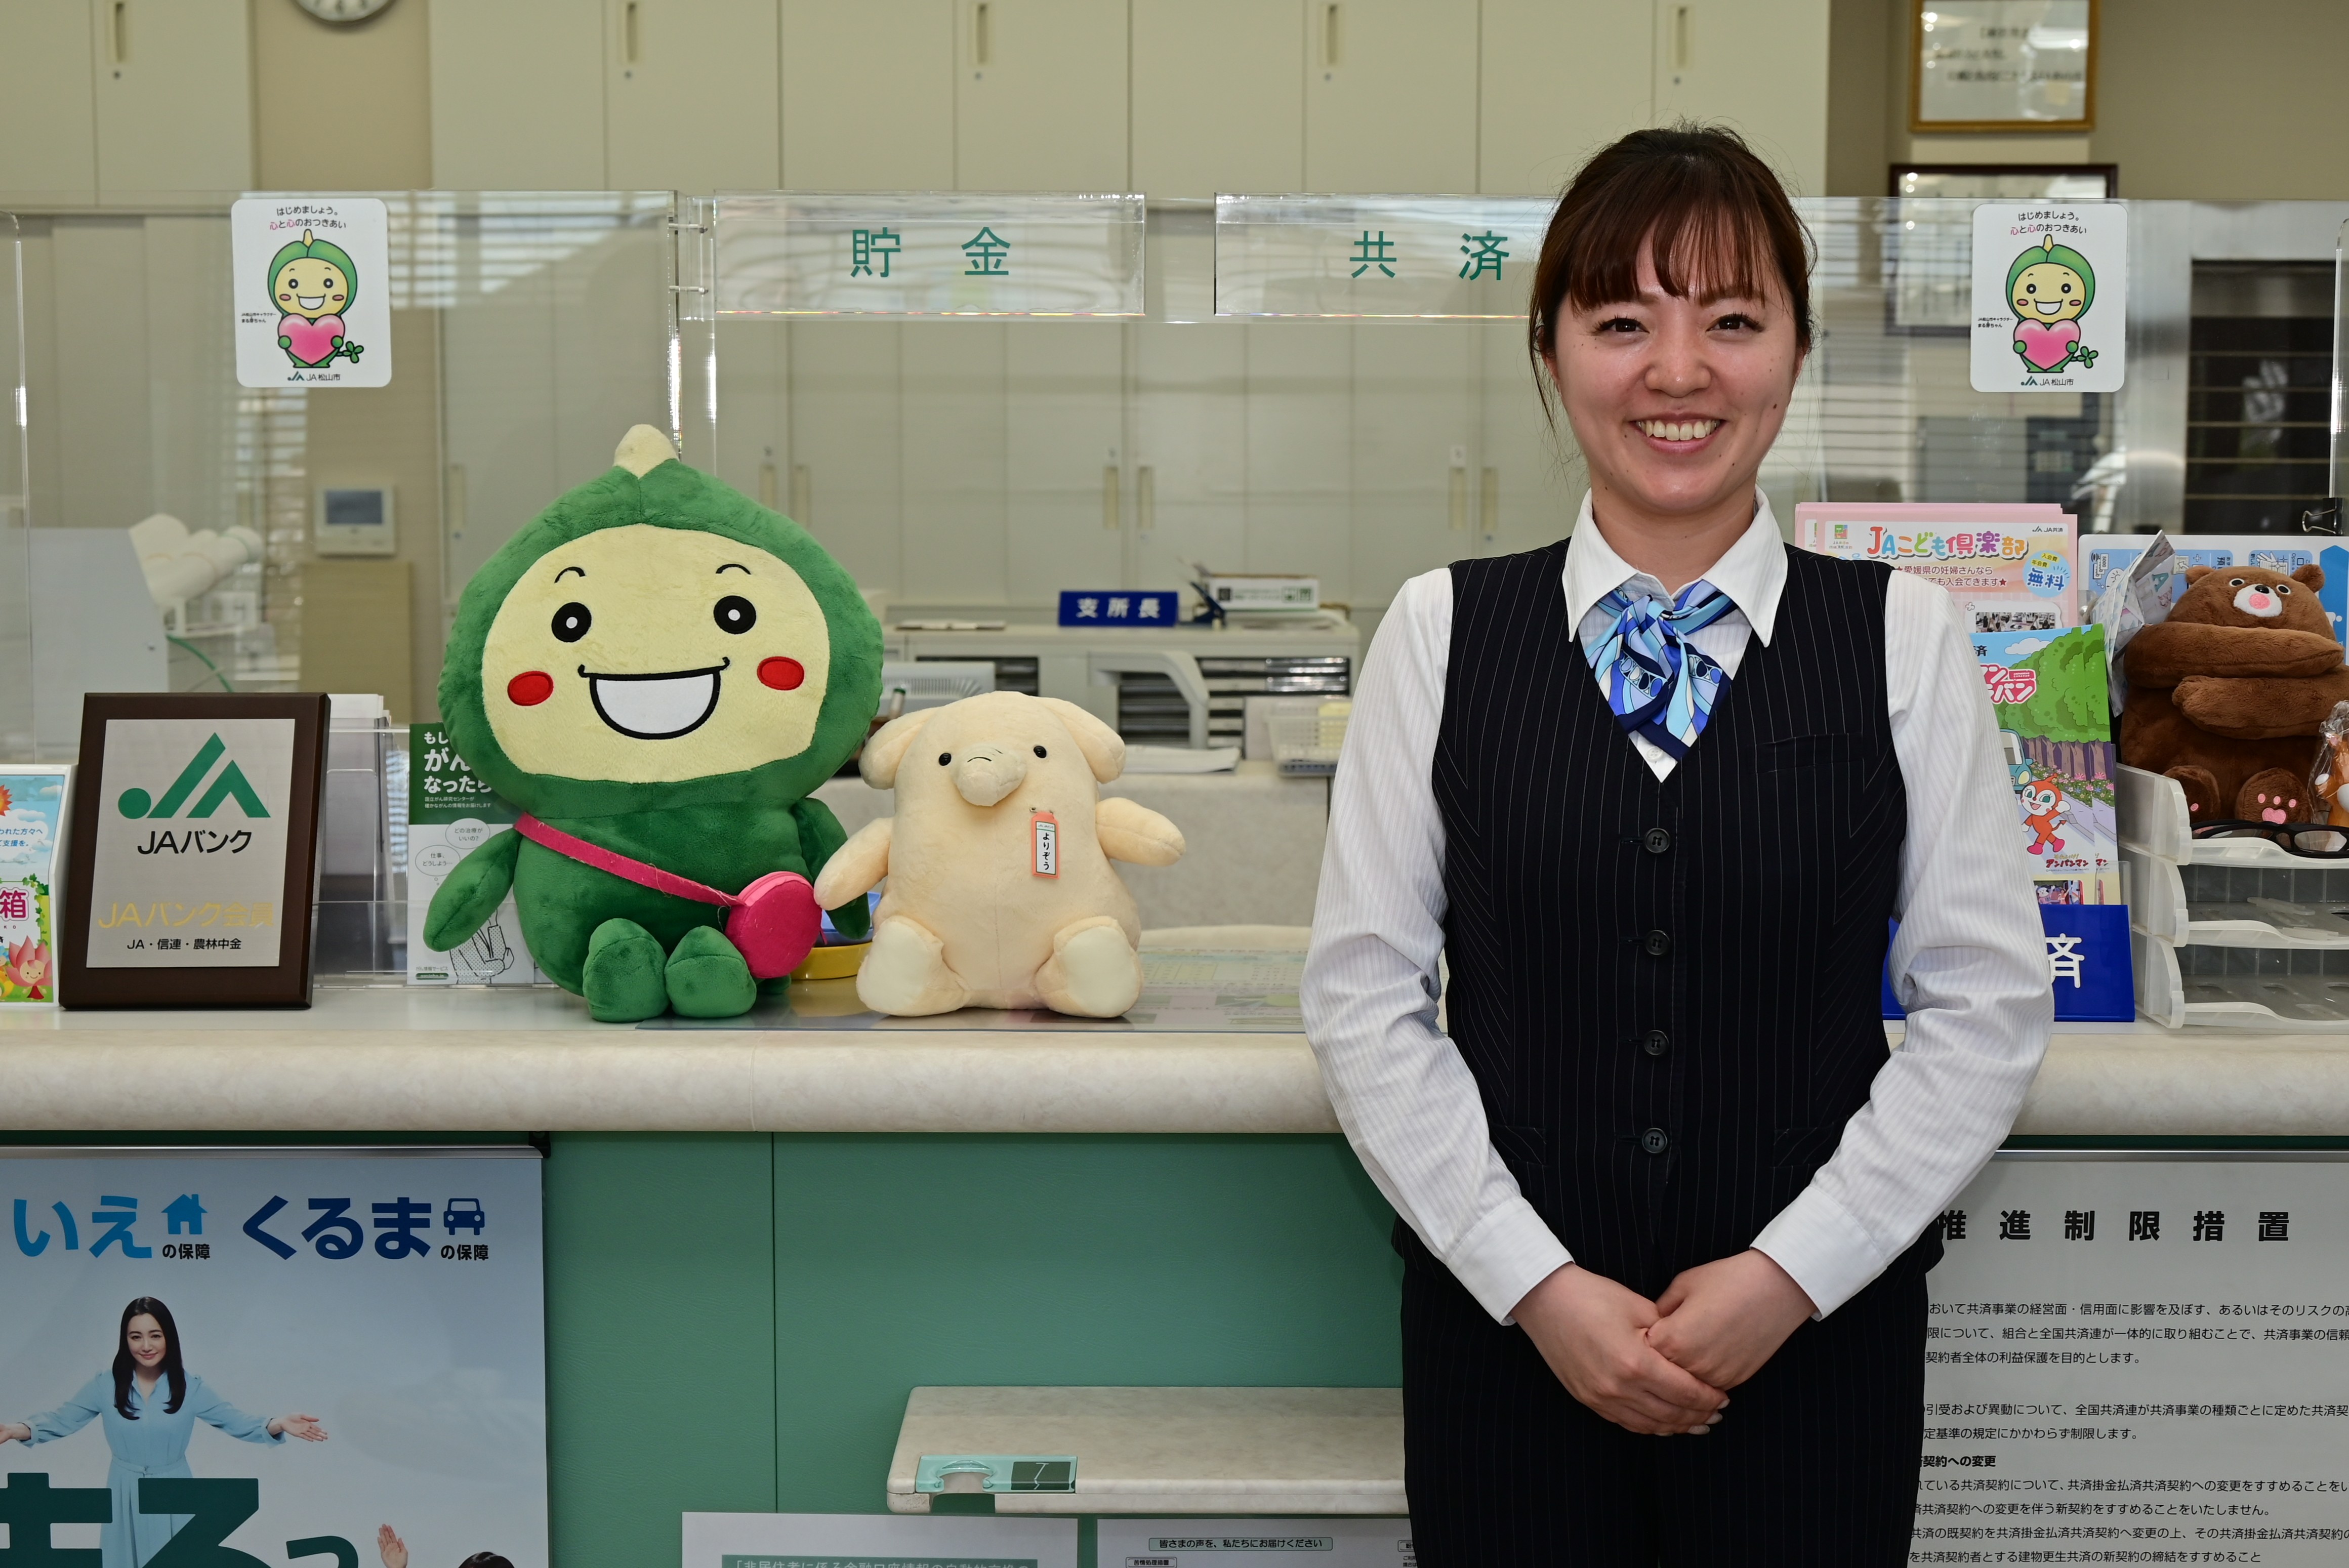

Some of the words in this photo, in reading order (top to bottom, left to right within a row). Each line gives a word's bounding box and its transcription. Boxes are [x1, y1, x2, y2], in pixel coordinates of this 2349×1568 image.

[276, 205, 339, 216] はじめましょう。
[2018, 211, 2079, 221] はじめましょう。
[269, 218, 346, 231] 心と心のおつきあい
[2010, 224, 2087, 235] 心と心のおつきあい
[1867, 526, 2026, 557] JAこども倶楽部
[2027, 567, 2065, 591] 無料
[1076, 597, 1161, 619] 支所長
[137, 830, 253, 854] JAバンク
[1042, 832, 1050, 870] よりぞう
[2045, 859, 2089, 868] アンパンマン
[97, 902, 273, 928] JAバンク会員
[13, 1195, 152, 1259] いえ
[162, 1243, 211, 1260] の保障
[242, 1194, 432, 1260] くるま
[440, 1244, 489, 1261] の保障
[1923, 1404, 2348, 1417] 引受および異動について、全国共済連が共済事業の種類ごとに定めた共済契
[1159, 1539, 1323, 1549] 皆さまの声を、私たちにお届けください
